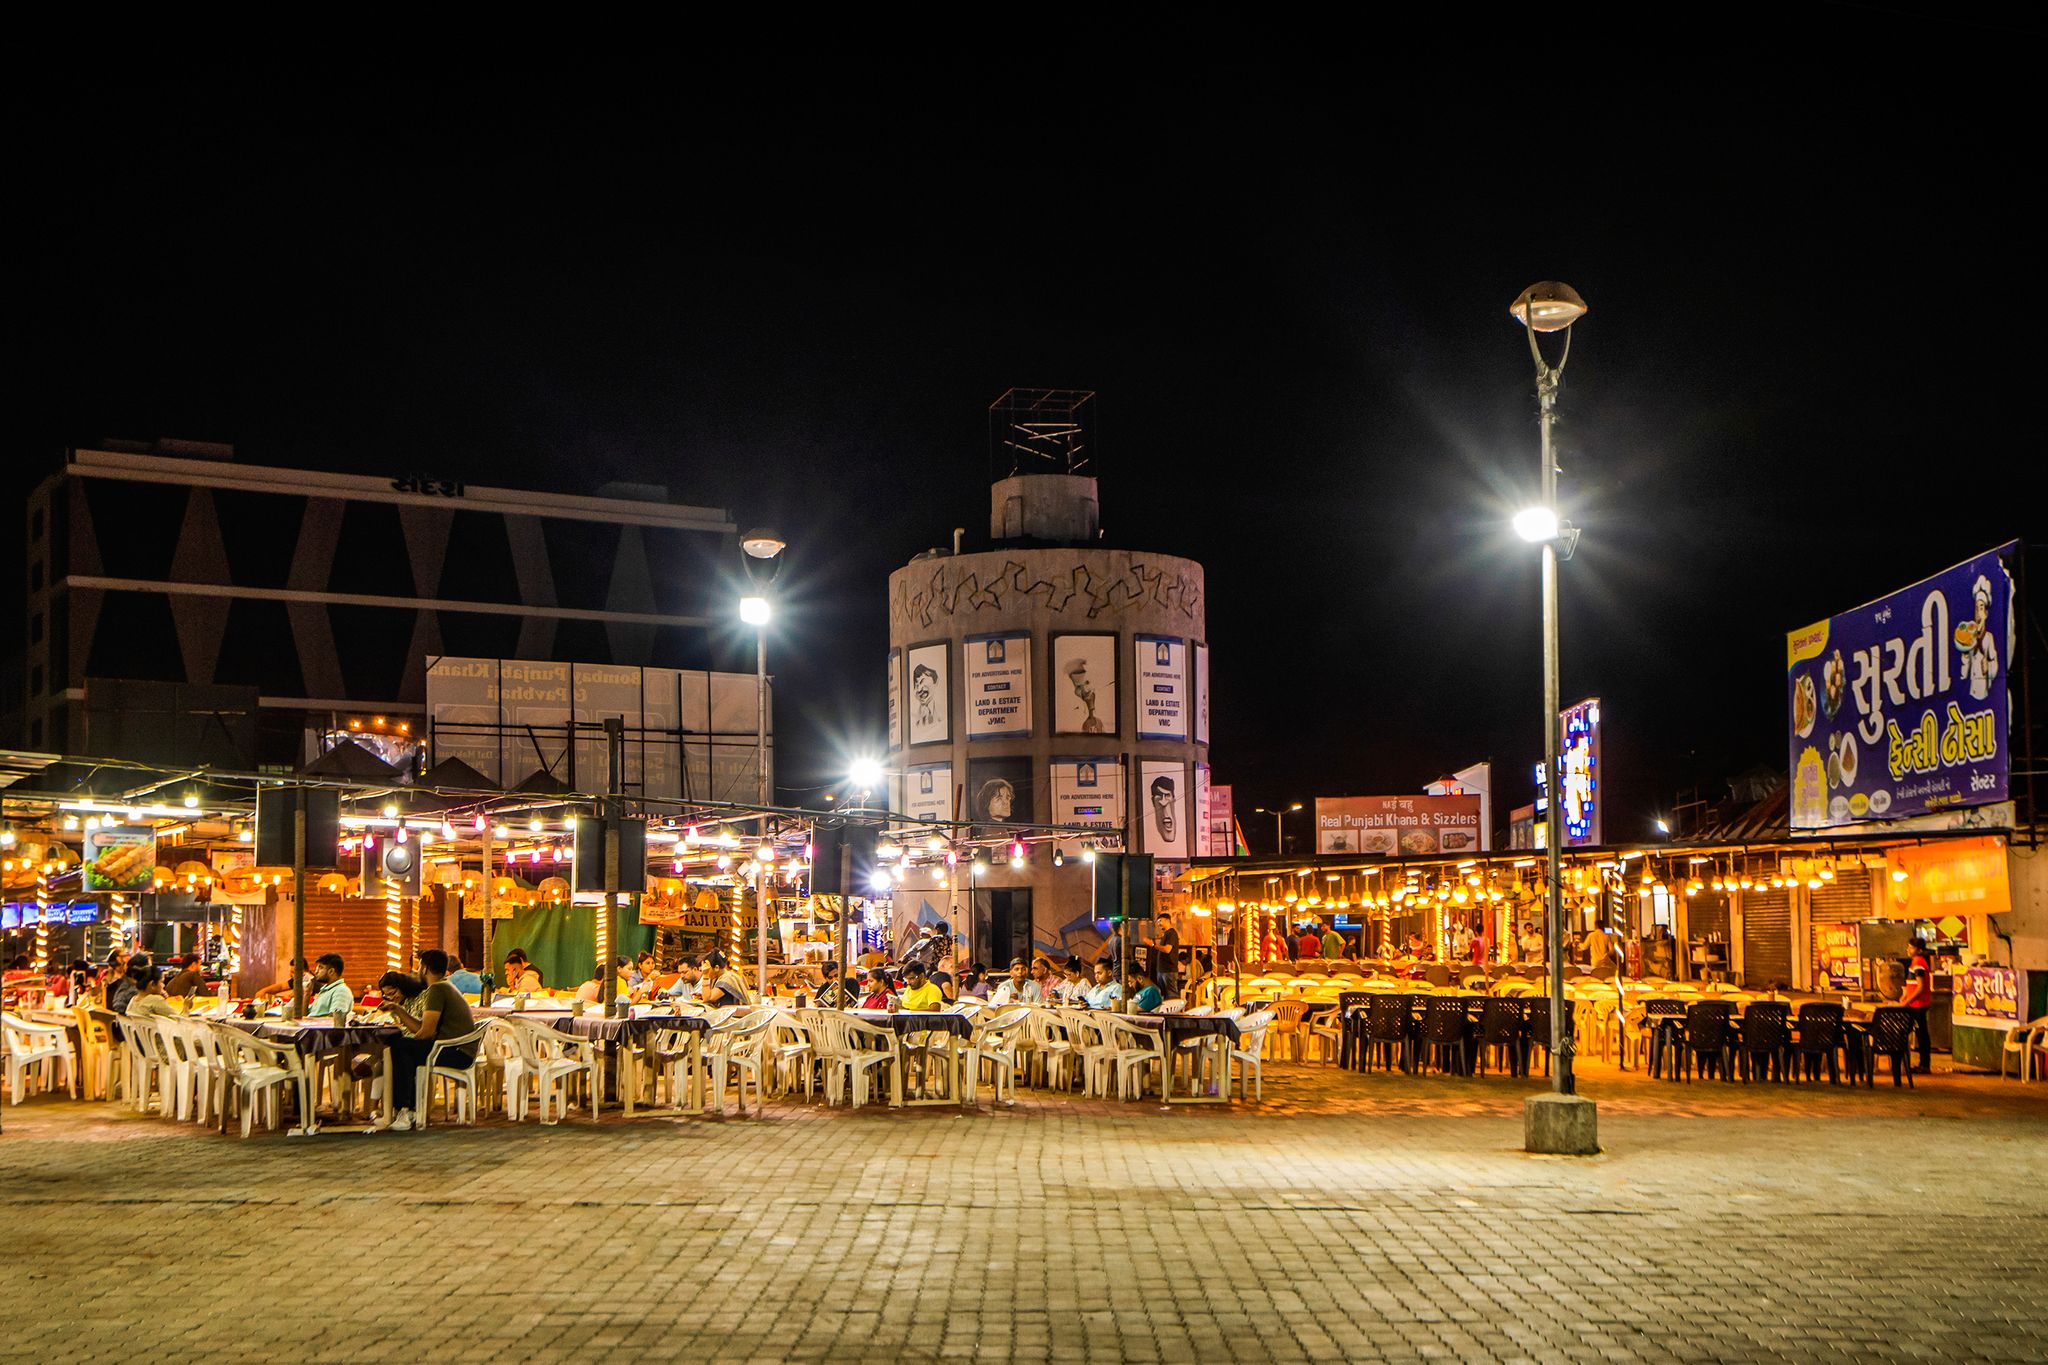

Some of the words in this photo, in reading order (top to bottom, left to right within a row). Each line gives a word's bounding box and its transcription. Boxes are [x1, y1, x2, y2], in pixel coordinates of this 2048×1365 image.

[1852, 589, 1951, 745] સુરતી
[975, 698, 990, 706] LAND
[998, 696, 1021, 705] ESTATE
[1166, 700, 1180, 708] ESTATE
[978, 706, 1018, 716] DEPARTMENT
[1148, 708, 1178, 717] DEPARTMENT
[1159, 719, 1171, 727] VMC
[1320, 815, 1342, 828] Real
[1344, 814, 1383, 829] Punjabi
[1386, 813, 1418, 826] Khana
[1421, 813, 1430, 825] &
[1434, 812, 1477, 825] Sizzlers
[1973, 971, 2004, 1000] સુરતી
